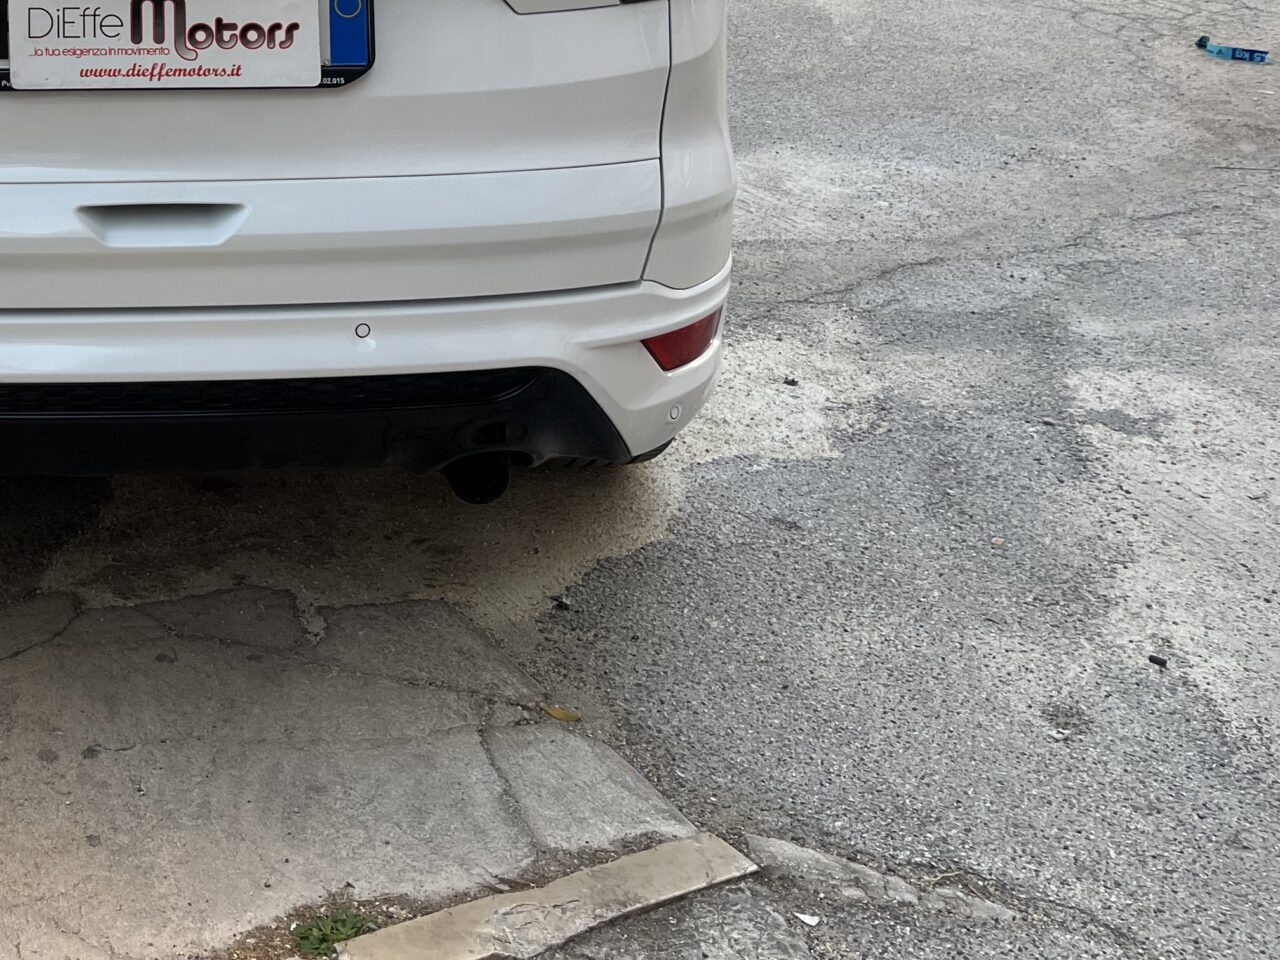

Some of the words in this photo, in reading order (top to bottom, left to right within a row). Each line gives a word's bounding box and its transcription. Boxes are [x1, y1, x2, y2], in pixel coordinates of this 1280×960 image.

[28, 6, 124, 39] DiEffe
[62, 46, 108, 58] esigenza
[117, 46, 170, 56] movimento
[80, 62, 242, 82] www.dieffemotors.it
